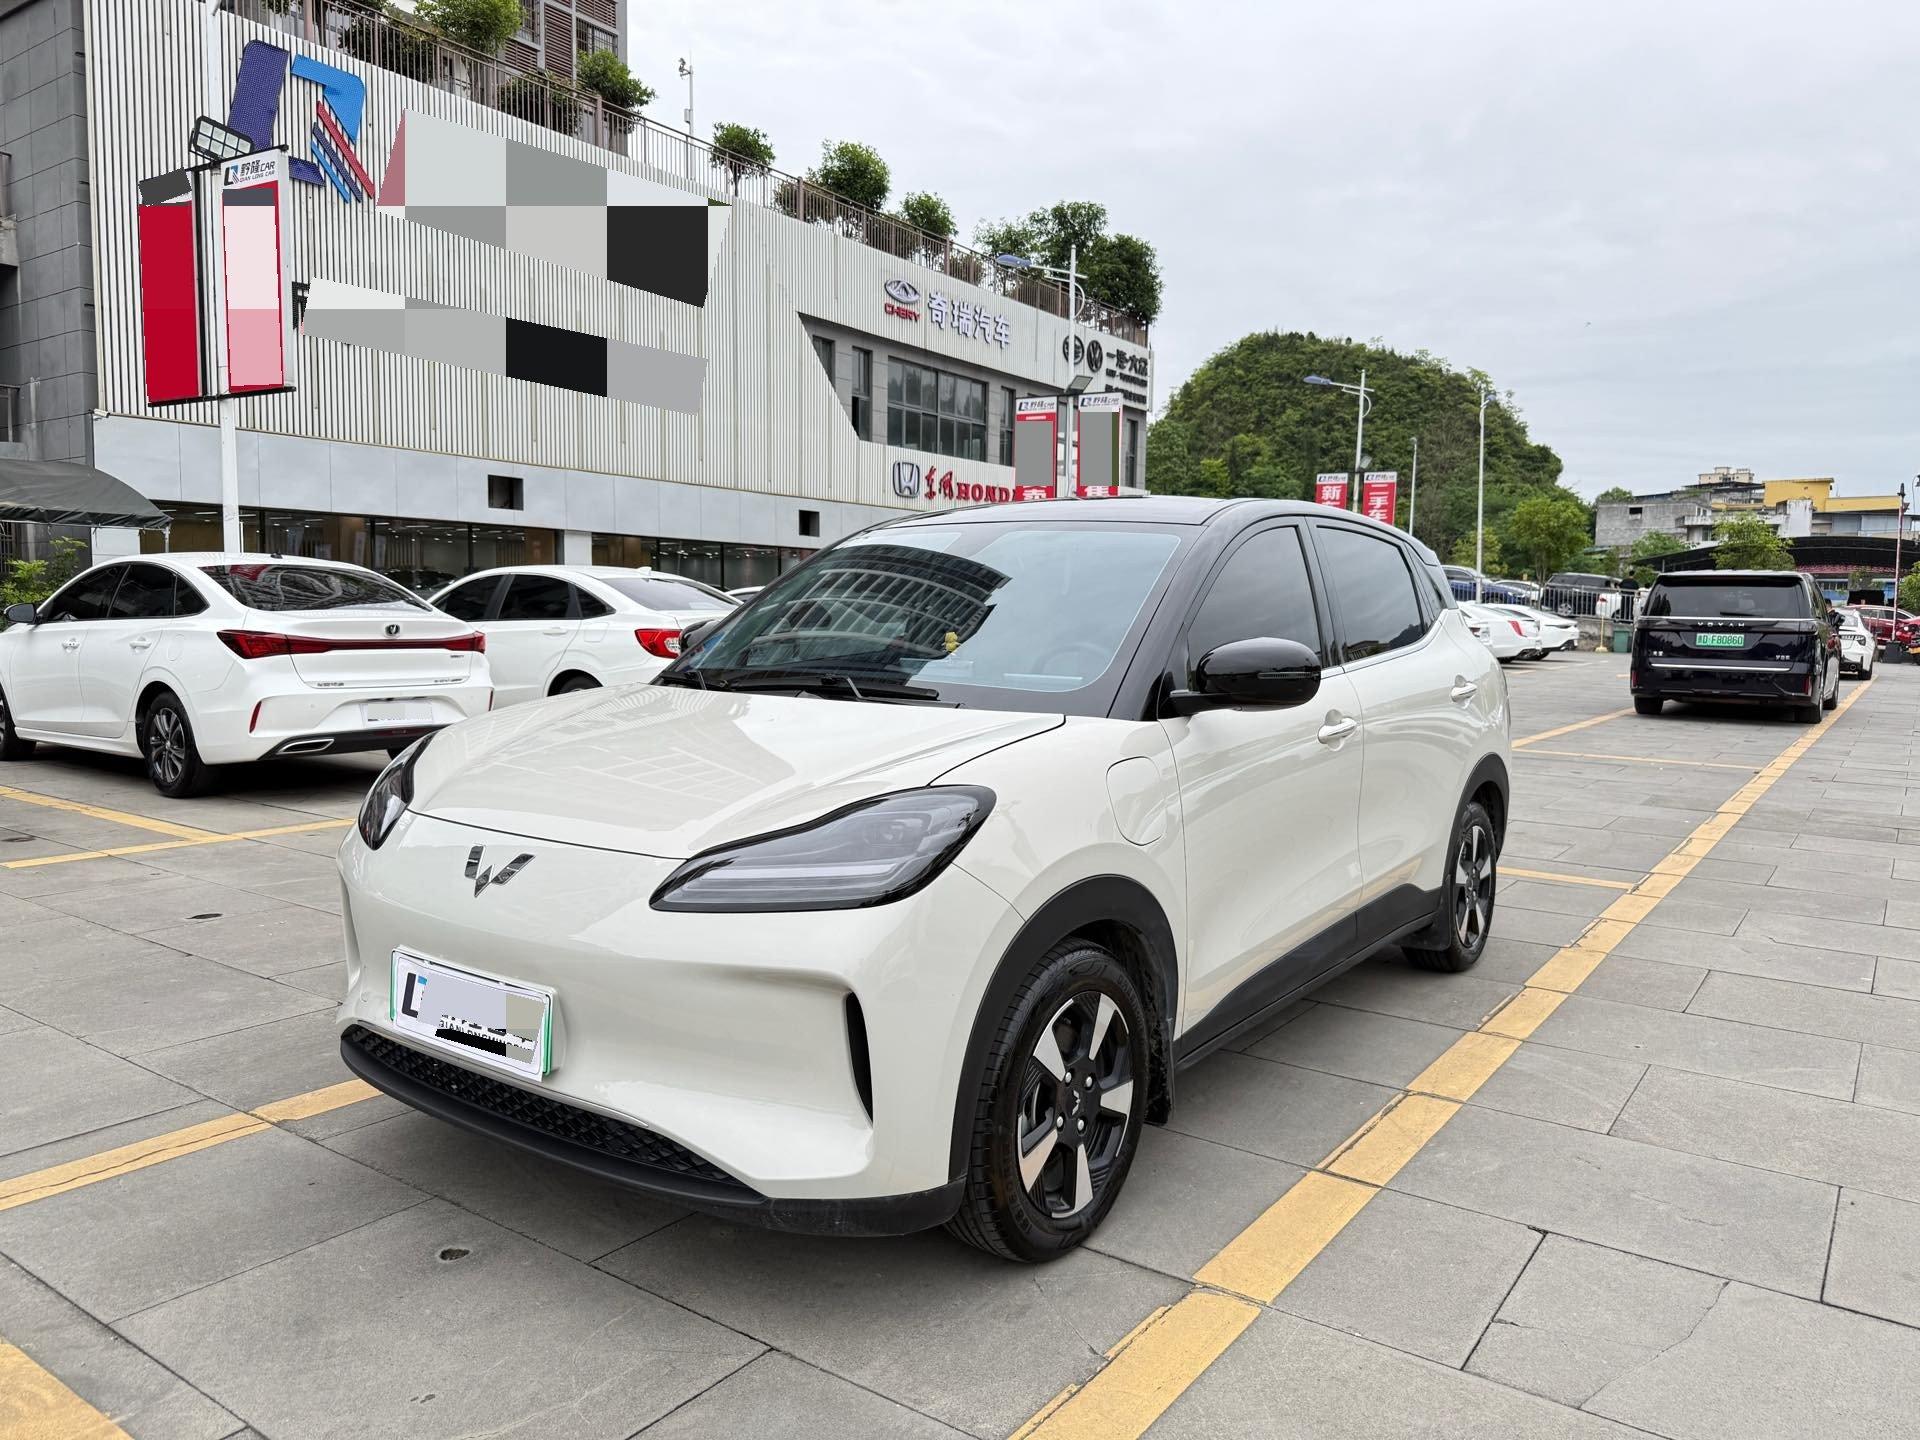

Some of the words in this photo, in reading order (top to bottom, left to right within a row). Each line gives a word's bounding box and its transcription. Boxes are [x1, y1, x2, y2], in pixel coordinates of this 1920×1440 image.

[884, 303, 921, 323] CHERY
[928, 291, 1010, 349] 奇瑞汽车
[956, 482, 1016, 502] HOND
[1368, 483, 1390, 520] 二手车
